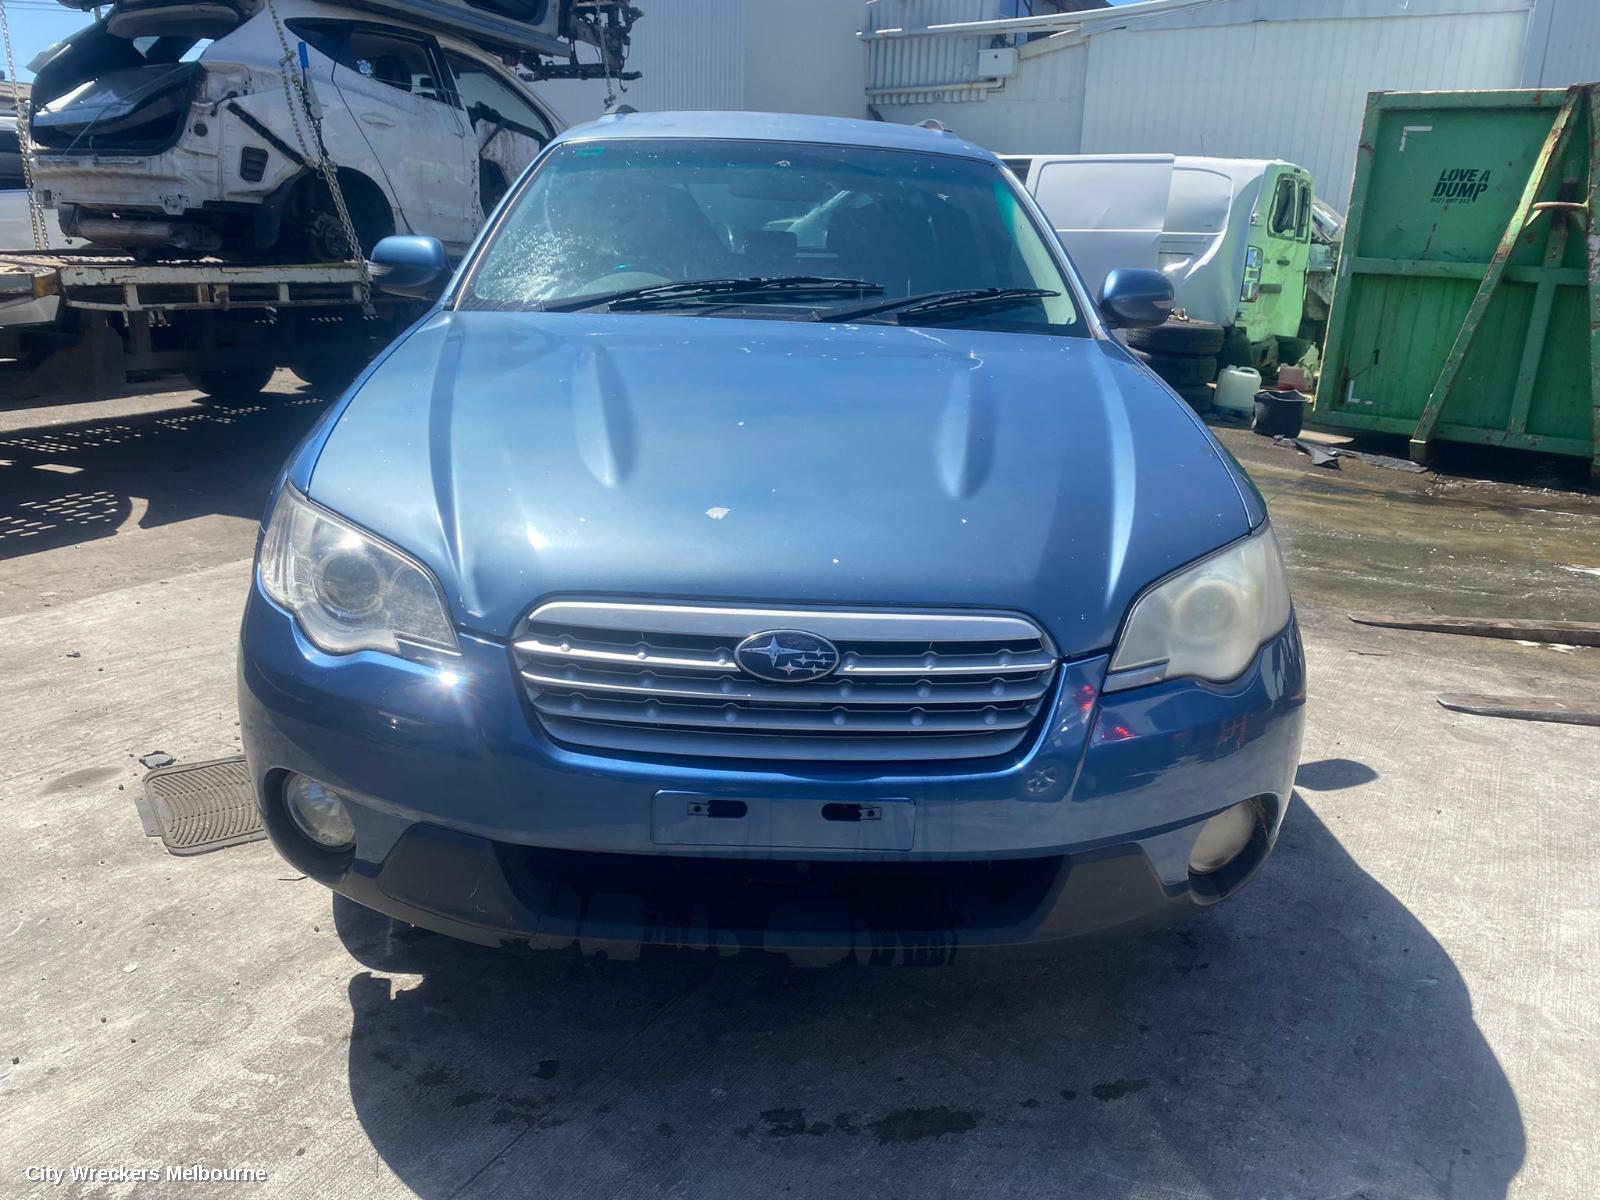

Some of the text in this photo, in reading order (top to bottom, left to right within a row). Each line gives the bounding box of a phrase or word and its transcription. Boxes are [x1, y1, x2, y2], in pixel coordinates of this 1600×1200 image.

[1439, 168, 1491, 182] LOVE A
[1432, 182, 1489, 203] DUMP
